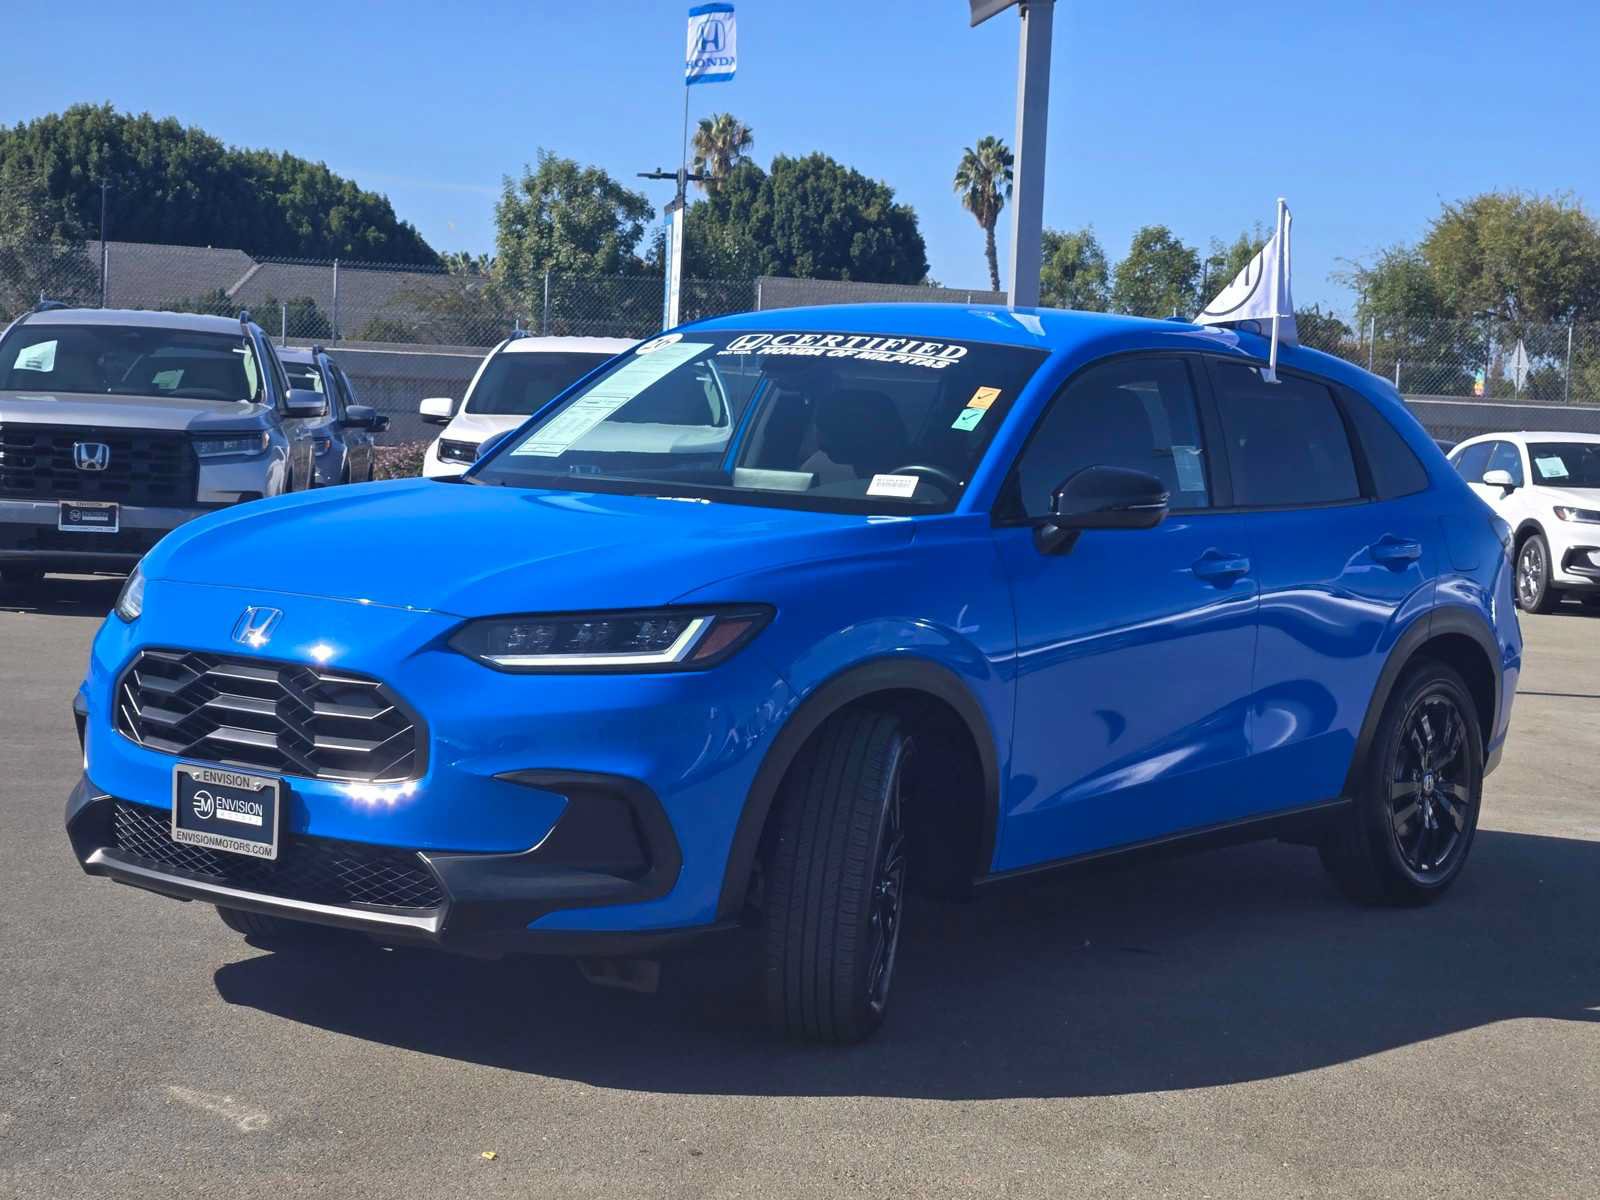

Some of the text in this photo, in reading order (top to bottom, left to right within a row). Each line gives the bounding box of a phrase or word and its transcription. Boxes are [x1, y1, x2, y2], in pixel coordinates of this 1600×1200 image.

[756, 346, 825, 356] HONDA
[826, 348, 857, 358] OF
[854, 350, 951, 369] MILPITAS
[770, 333, 968, 359] CERTIFIED
[203, 770, 250, 788] ENVISION
[216, 796, 263, 816] ENVISION
[176, 830, 273, 857] ENVISIONMOTORS.COM
